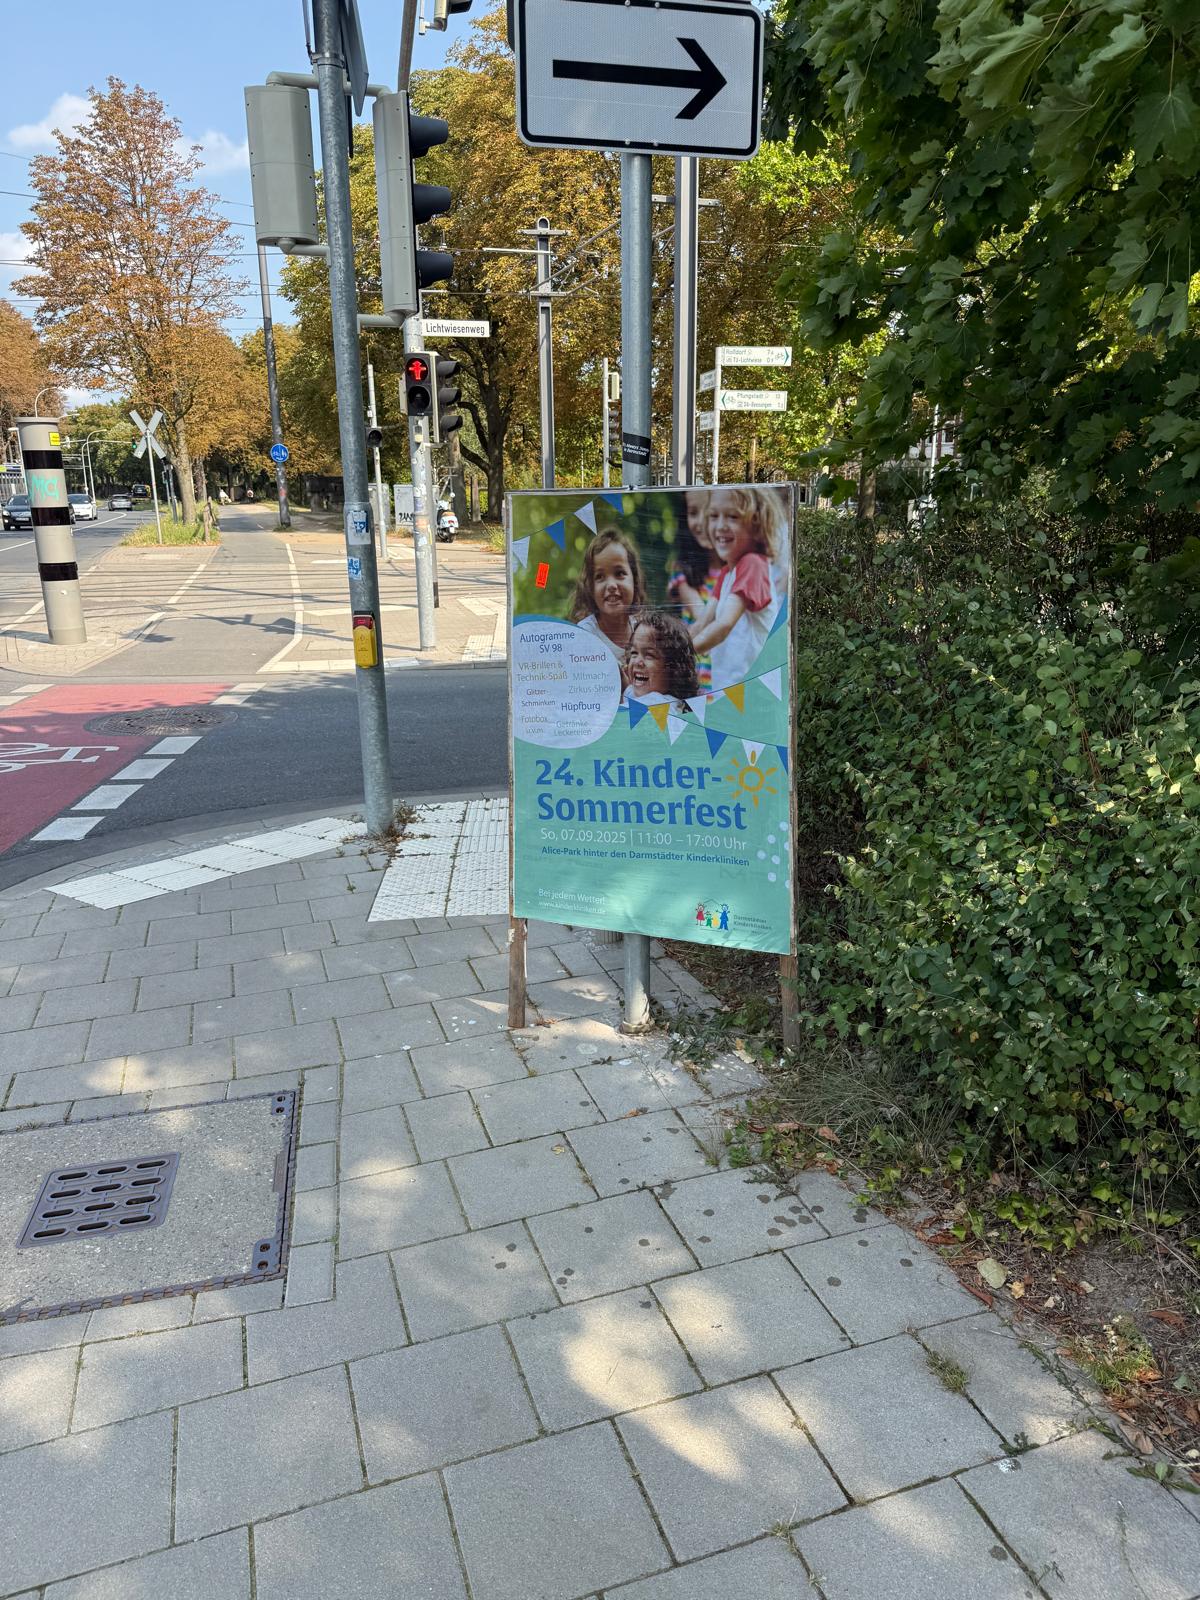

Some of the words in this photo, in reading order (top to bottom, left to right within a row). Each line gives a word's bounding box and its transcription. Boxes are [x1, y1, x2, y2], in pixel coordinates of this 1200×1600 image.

[425, 322, 485, 336] Lichtwiesenweg
[520, 631, 575, 643] Autogramme
[539, 644, 550, 654] SV
[551, 643, 563, 653] 98
[569, 652, 606, 663] Torwand
[518, 661, 557, 671] VR-Brillen
[517, 671, 568, 682] Technik-Spaß
[521, 699, 556, 708] Schminken
[561, 701, 601, 712] Hüpfburg
[535, 758, 584, 787] 24.
[593, 757, 722, 790] Kinder-
[537, 793, 748, 830] Sommerfest
[540, 828, 558, 841] So,
[560, 828, 627, 845] 07.09.2025
[637, 832, 672, 846] 11:00
[686, 833, 721, 848] 17:00
[723, 836, 747, 851] Uhr
[541, 845, 582, 857] Alice-Park
[583, 848, 609, 858] hinter
[610, 849, 627, 859] den
[629, 850, 684, 862] Darmstädter
[686, 852, 750, 867] Kinderkliniken
[551, 889, 576, 901] jedem
